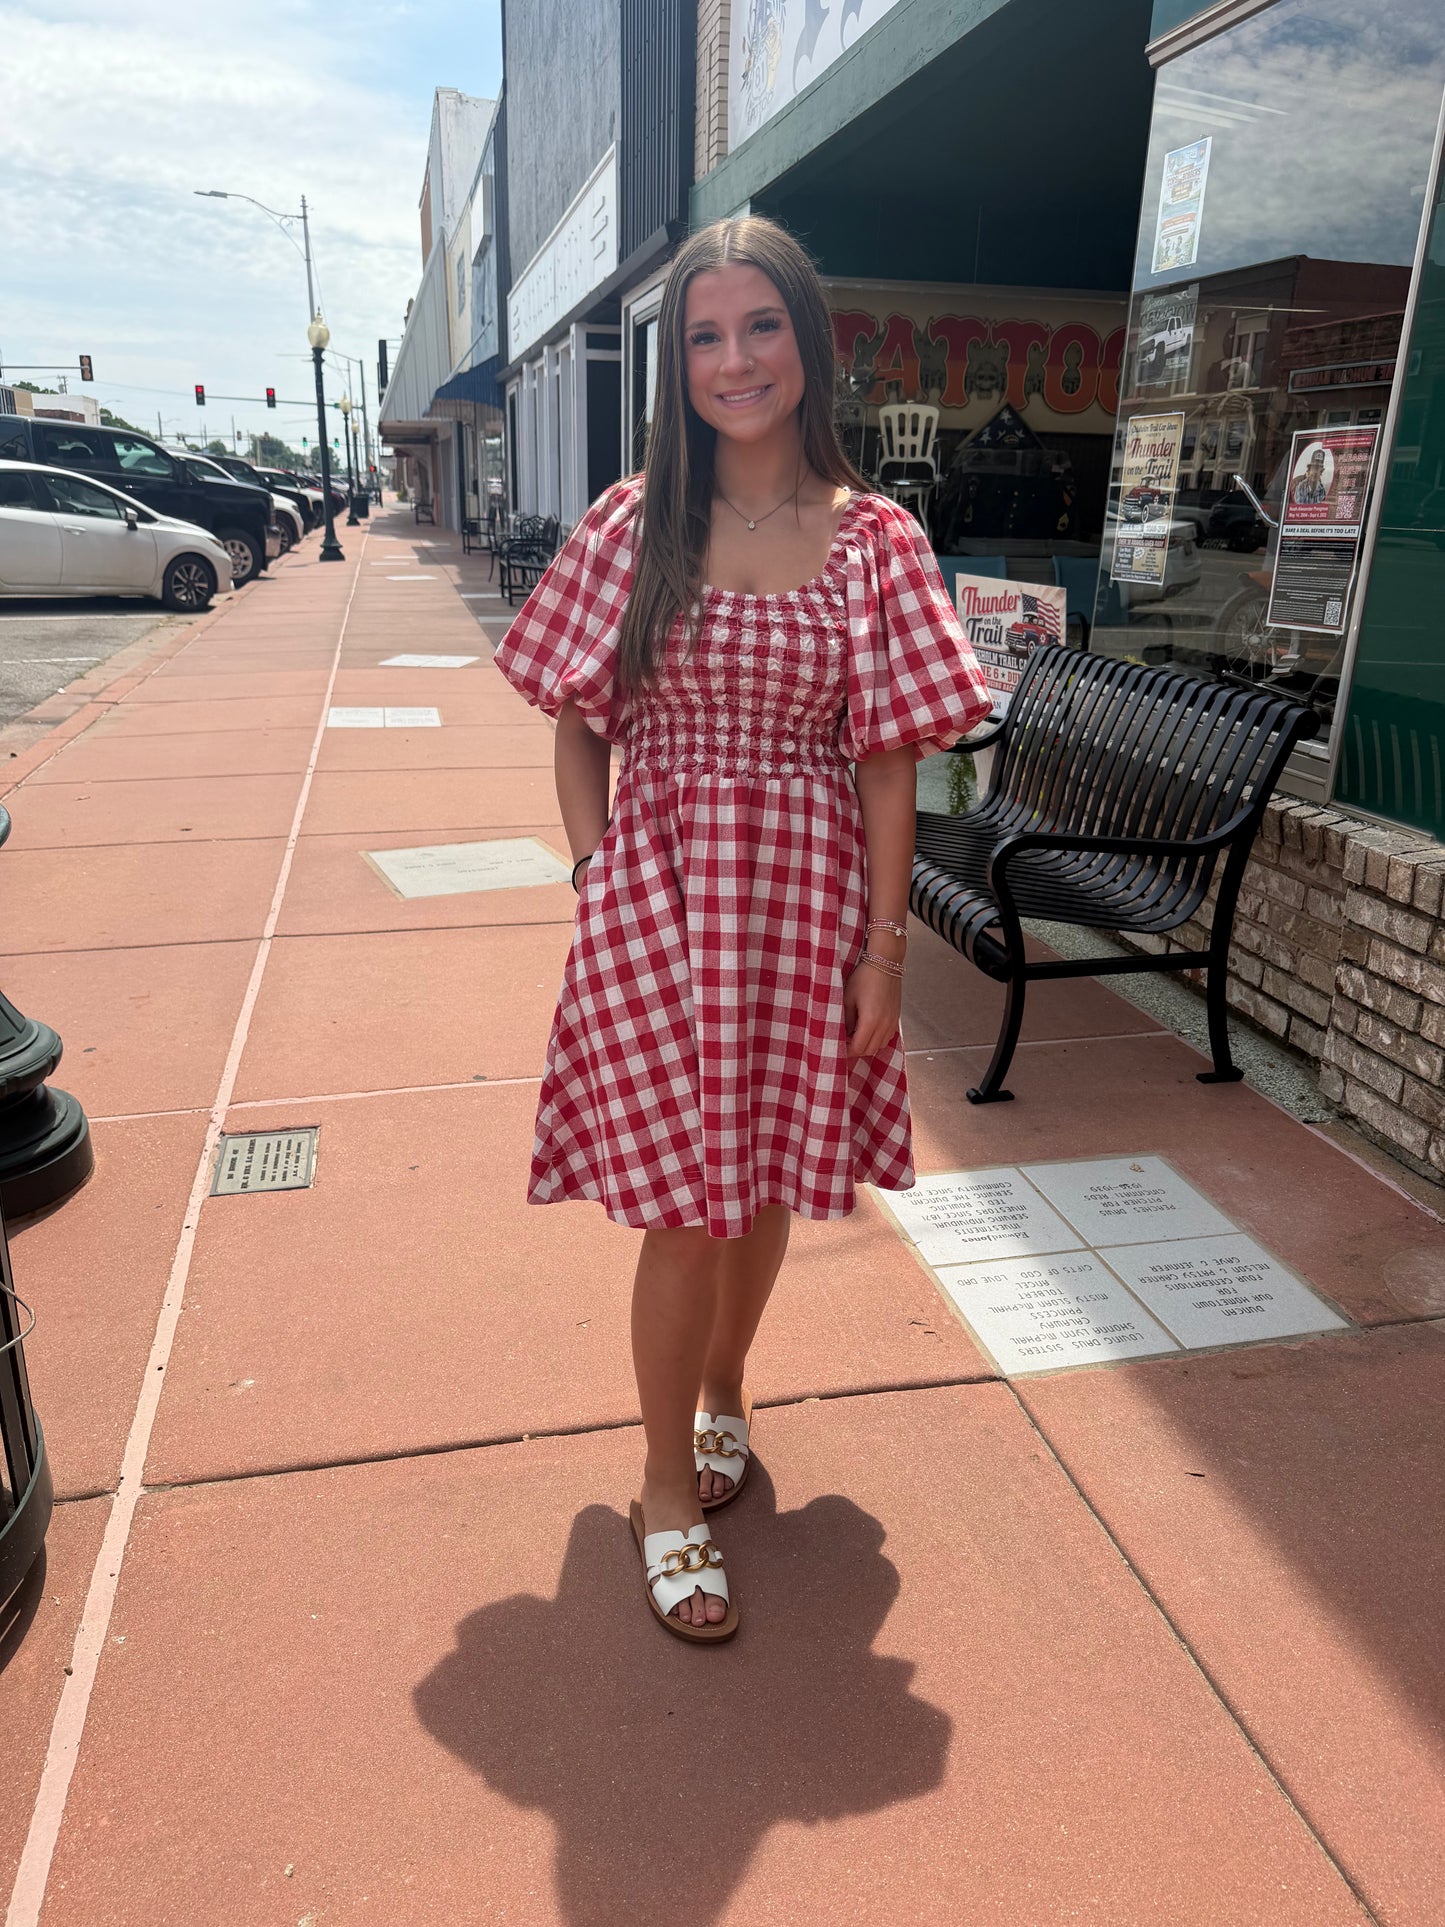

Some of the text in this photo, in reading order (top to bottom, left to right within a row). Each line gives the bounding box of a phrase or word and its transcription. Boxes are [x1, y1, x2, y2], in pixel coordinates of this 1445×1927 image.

[1131, 437, 1176, 459] Thunder
[1145, 458, 1174, 479] Trail
[962, 586, 1020, 616] Thunder
[984, 618, 990, 626] on
[966, 617, 1002, 645] Trail
[999, 654, 1018, 669] TRAIL
[994, 667, 999, 680] 6
[898, 1180, 1013, 1198] COMMUNITY SINCE 1982
[1112, 1188, 1167, 1198] CINCINNATI
[909, 1188, 1014, 1205] SERVING THE DUNCAN
[985, 1197, 1006, 1205] TED
[1120, 1196, 1163, 1205] PITCHER
[919, 1203, 1027, 1221] INVESTORS SINCE 1871
[1096, 1208, 1128, 1216] DAVIS
[931, 1212, 1030, 1229] SERVING INDIVIDUAL
[952, 1222, 1021, 1235] INVESTMENTS
[1147, 1260, 1197, 1272] JENNIFER
[1229, 1262, 1271, 1273] NELSON
[979, 1273, 1009, 1283] LOVE
[1136, 1273, 1180, 1283] GARNER
[1179, 1269, 1217, 1279] PATSY
[954, 1277, 978, 1286] DAD
[1162, 1273, 1264, 1291] FOUR GENERATIONS
[1015, 1287, 1064, 1299] TOLBERT
[1214, 1286, 1239, 1295] FOR
[986, 1292, 1109, 1314] MISTY SLOAN McPHAIL
[1190, 1292, 1274, 1309] OUR HOMETOWN
[1219, 1304, 1266, 1317] DUNCAN
[1036, 1316, 1092, 1330] CALAWAY
[1007, 1321, 1136, 1345] SHONNA LYNN McPHAIL
[1101, 1331, 1145, 1345] LOVING
[1016, 1342, 1064, 1356] SISTERS
